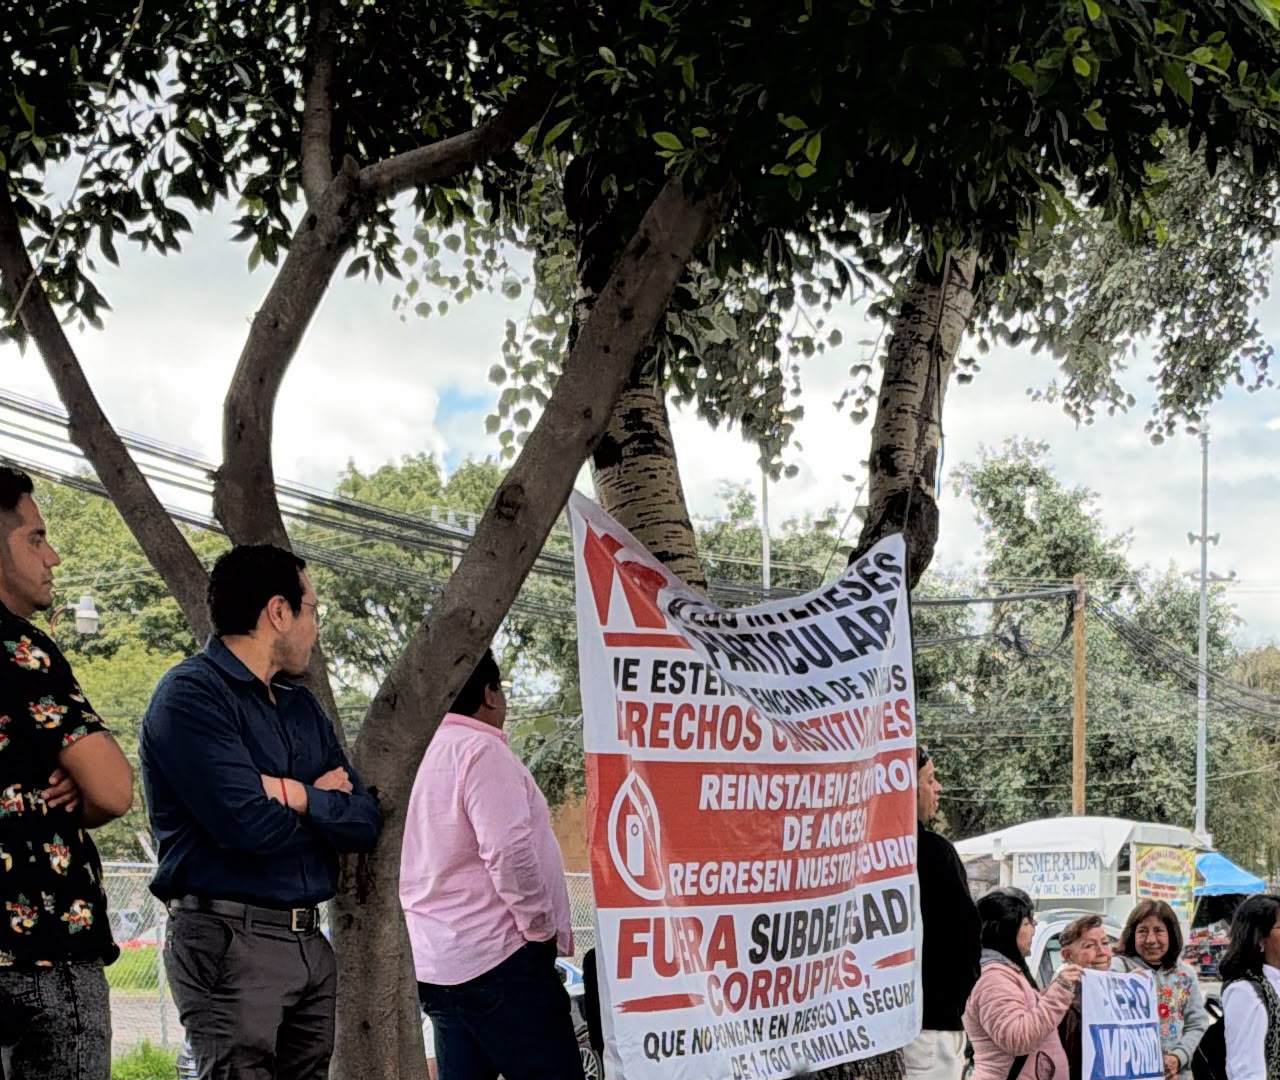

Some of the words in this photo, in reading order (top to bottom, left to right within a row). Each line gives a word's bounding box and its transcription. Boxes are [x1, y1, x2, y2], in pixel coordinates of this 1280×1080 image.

[825, 677, 864, 703] DE
[616, 700, 762, 751] RECHOS
[699, 770, 847, 811] REINSTALEN
[783, 815, 815, 852] DE
[816, 806, 867, 851] ACCESO
[669, 860, 790, 897] REGRESEN
[796, 850, 856, 890] NUESTRA
[1018, 851, 1097, 874] ESMERALDA
[1047, 873, 1060, 882] LA
[1063, 883, 1096, 896] SABOR
[644, 1029, 686, 1063] QUE
[692, 1026, 713, 1054] NO
[769, 1013, 789, 1041] EN
[792, 1002, 837, 1036] RIESGO
[841, 995, 863, 1022] LA
